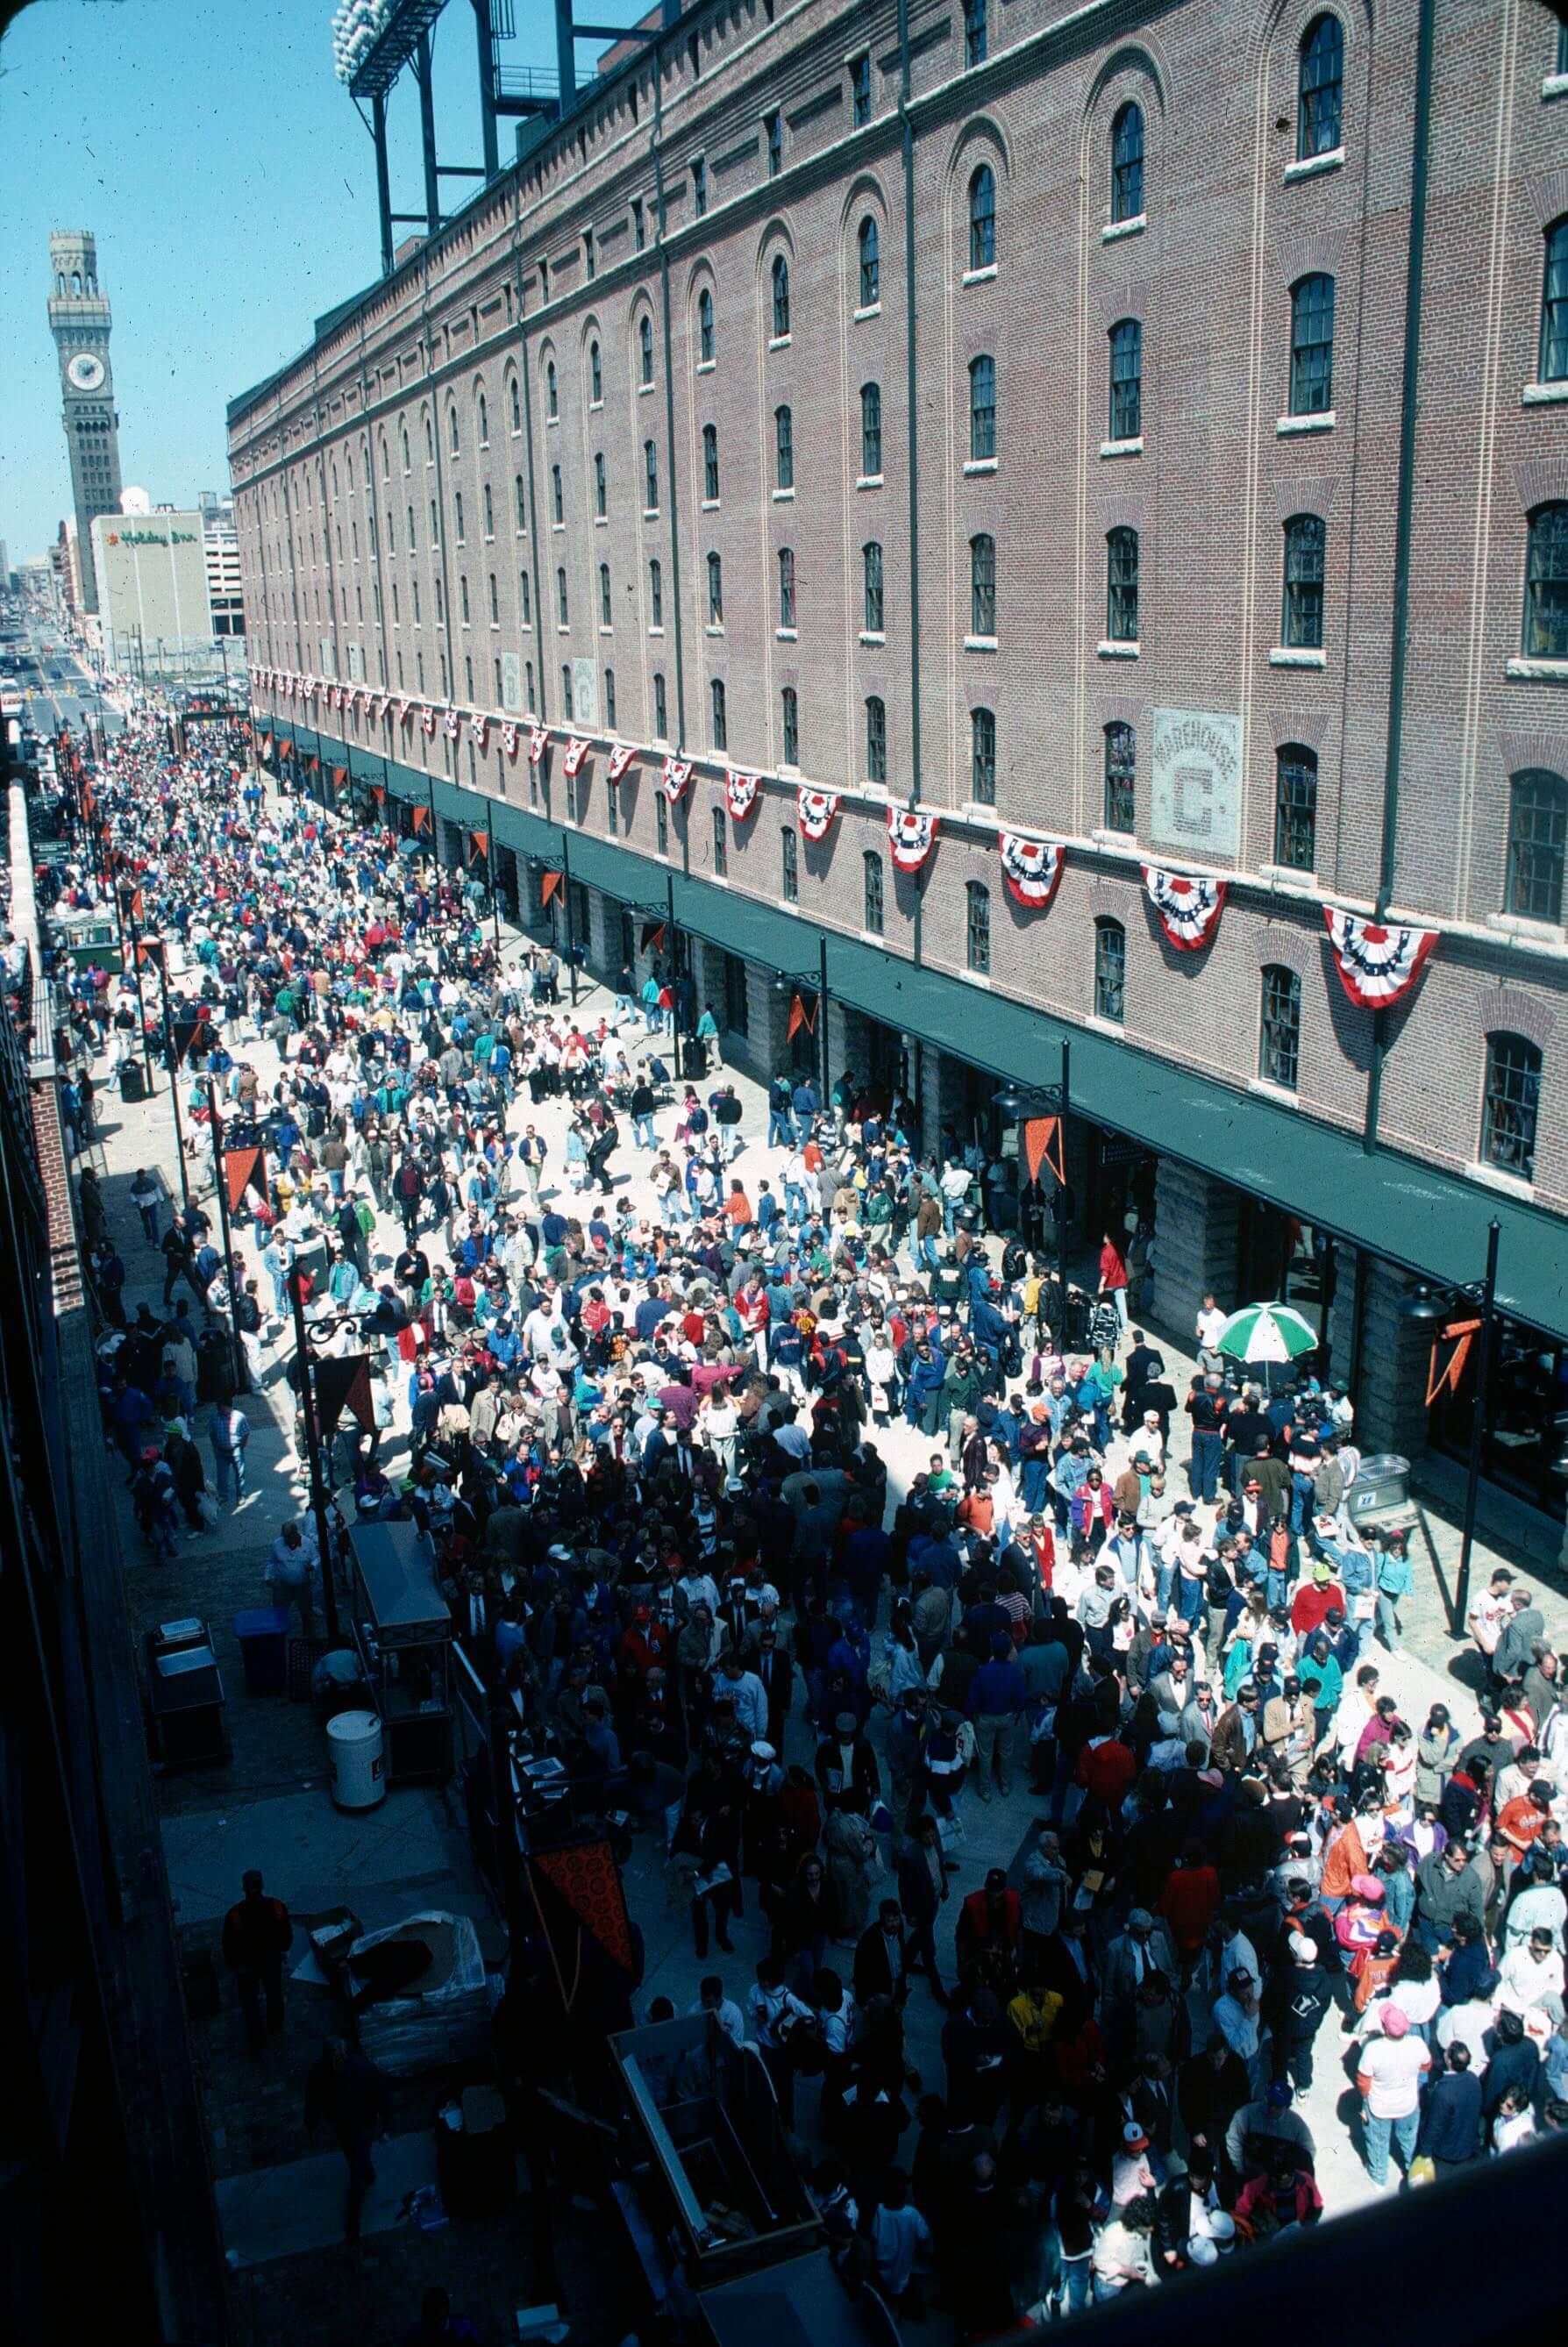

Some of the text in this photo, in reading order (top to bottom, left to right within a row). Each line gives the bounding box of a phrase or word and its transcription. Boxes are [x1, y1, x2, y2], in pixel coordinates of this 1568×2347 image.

[120, 531, 197, 547] Holiday Inn
[1173, 767, 1213, 836] C
